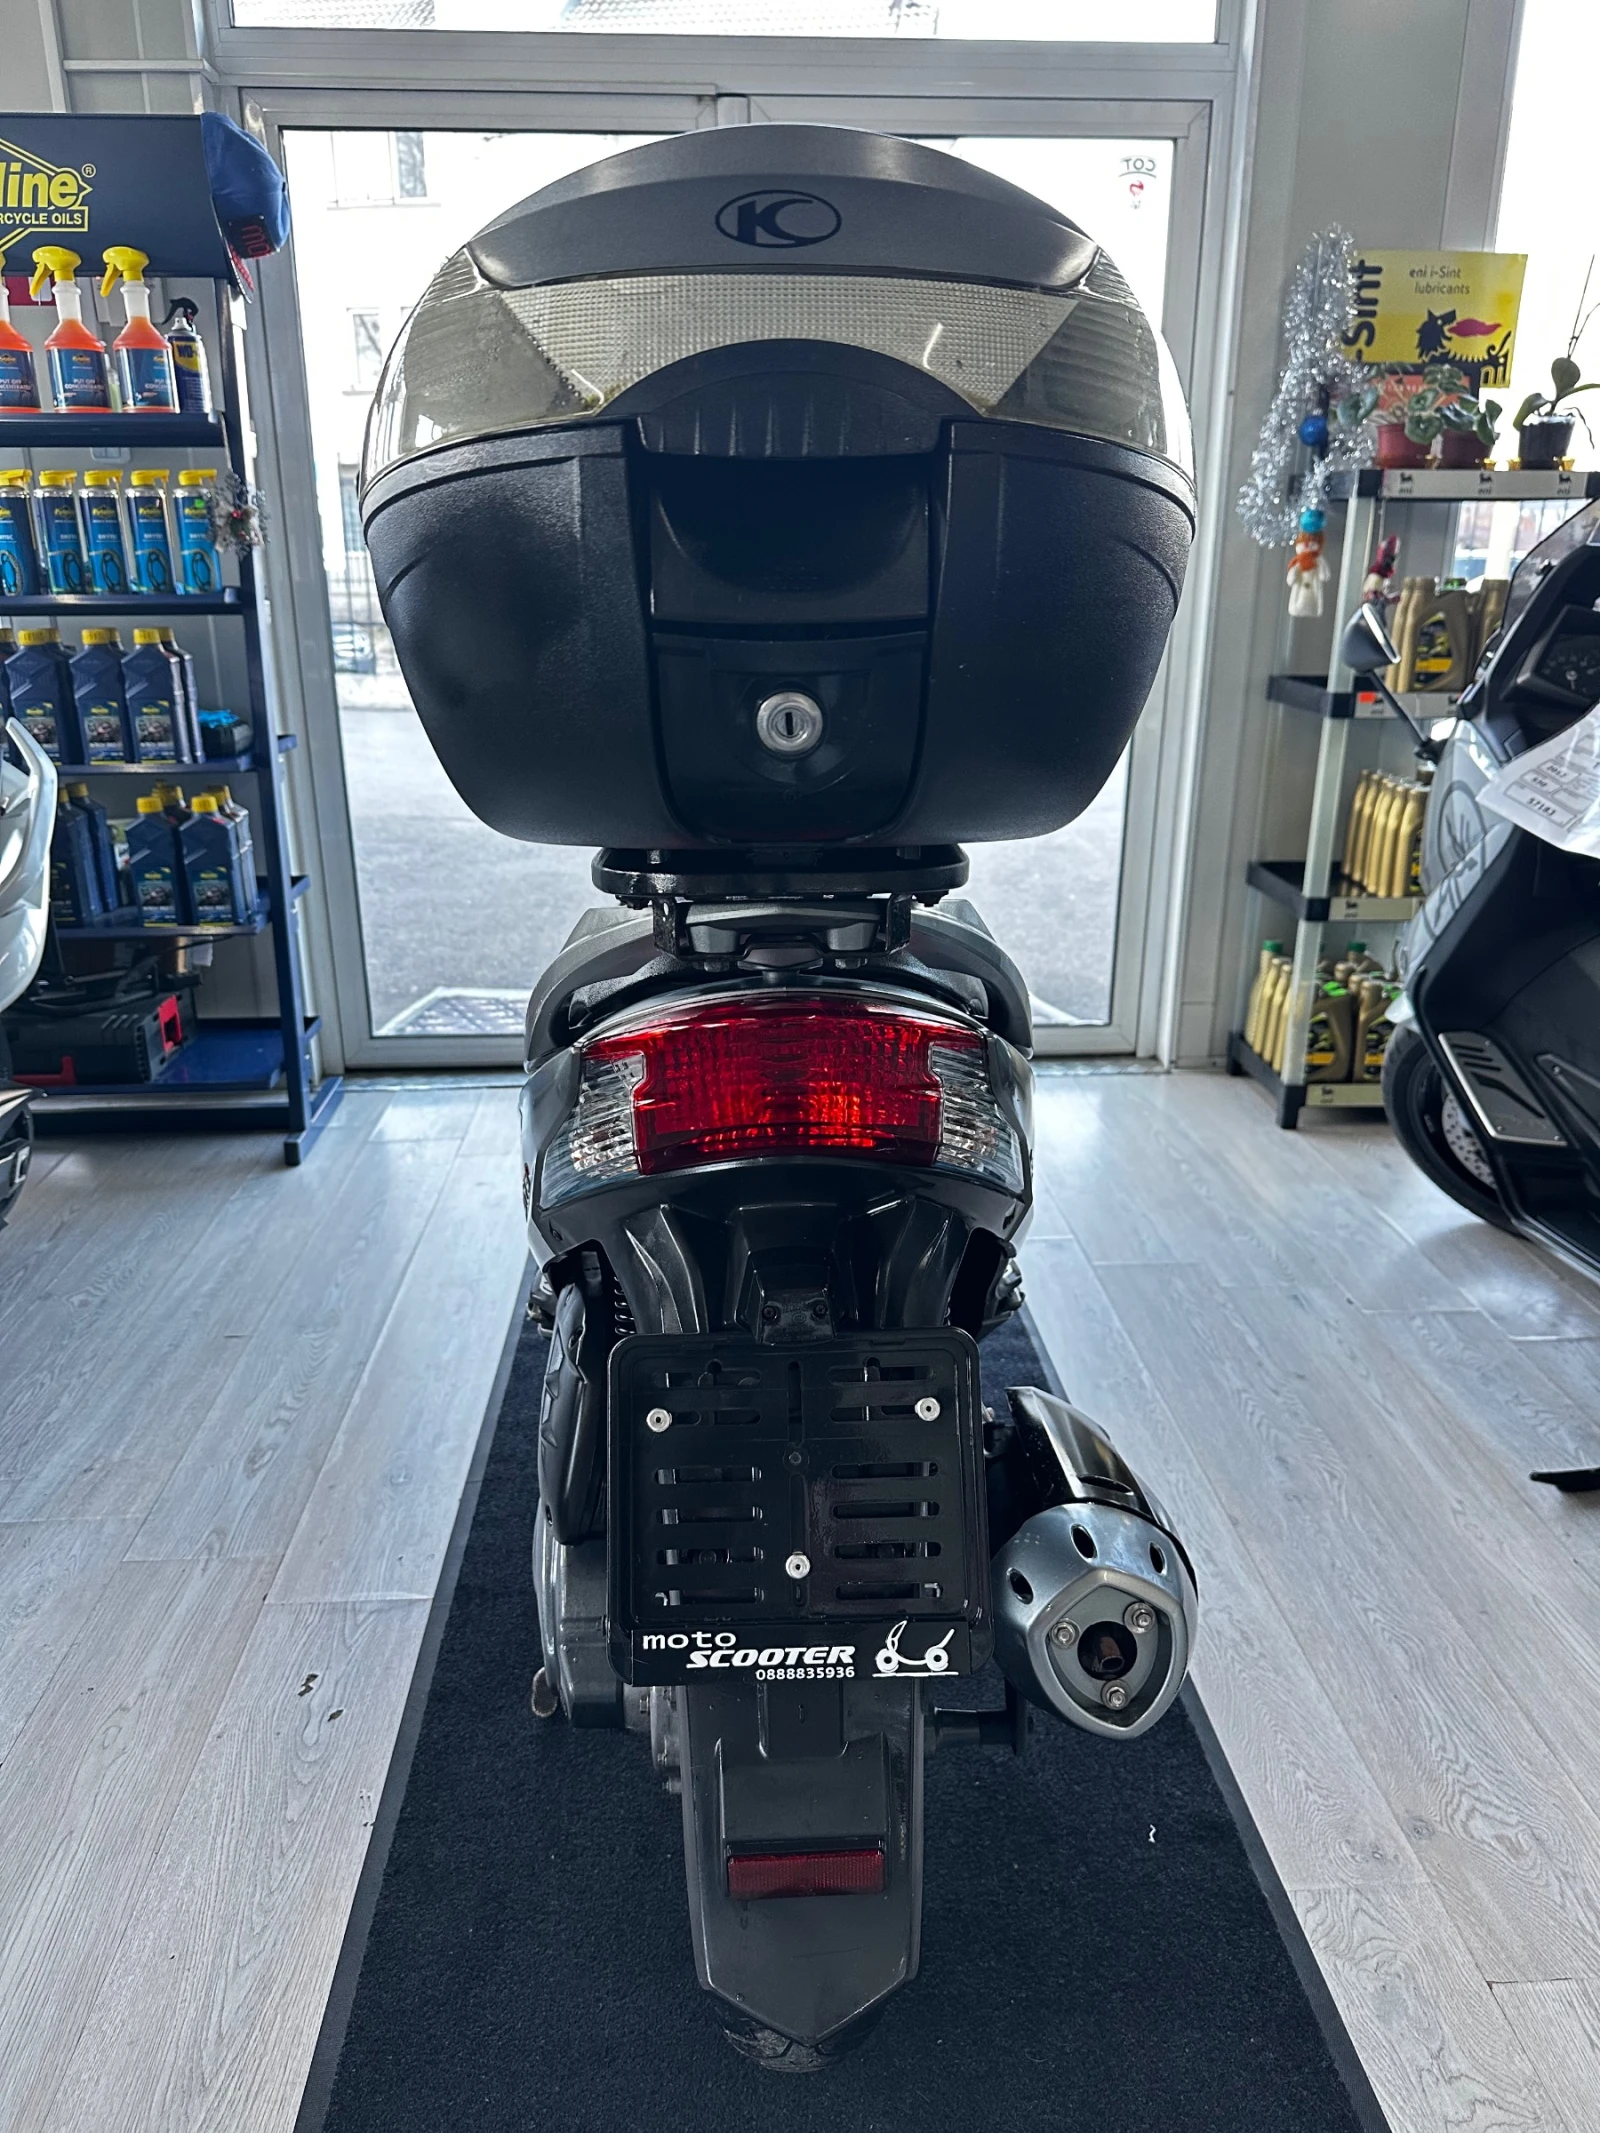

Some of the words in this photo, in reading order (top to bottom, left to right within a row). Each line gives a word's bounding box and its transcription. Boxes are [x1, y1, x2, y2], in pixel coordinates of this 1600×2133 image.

[52, 212, 82, 225] OILS
[1409, 265, 1427, 279] eni
[1415, 281, 1470, 295] lubricants
[642, 1631, 737, 1650] moto
[686, 1645, 856, 1669] SCOOTER
[755, 1665, 856, 1681] 0888835936
